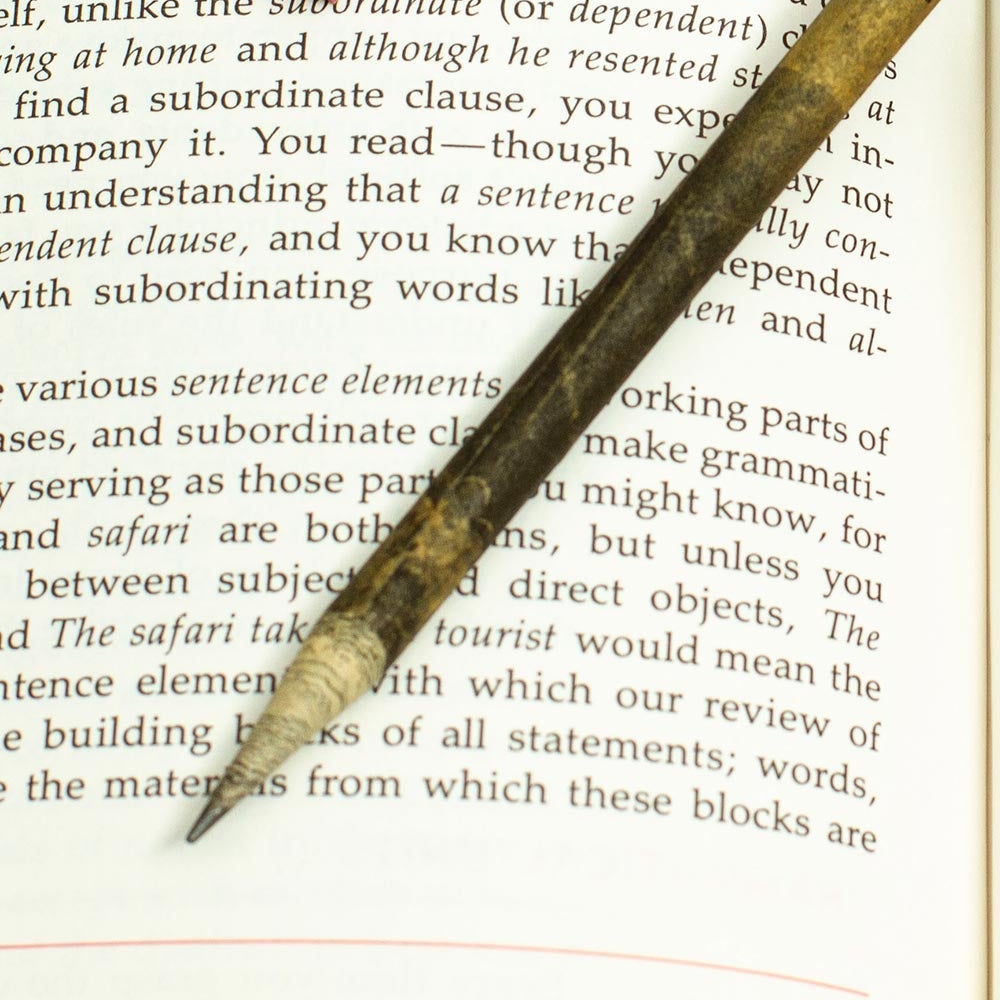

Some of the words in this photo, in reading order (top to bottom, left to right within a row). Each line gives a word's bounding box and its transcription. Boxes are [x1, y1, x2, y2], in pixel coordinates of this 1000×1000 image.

[122, 36, 218, 67] home
[236, 31, 309, 63] and
[328, 31, 489, 73] although
[568, 49, 719, 83] resented
[13, 86, 90, 120] find
[149, 78, 385, 113] subordinate
[405, 79, 537, 119] clause,
[559, 95, 632, 126] you
[188, 128, 225, 157] it.
[251, 126, 328, 156] You
[43, 173, 329, 213] understanding
[477, 182, 635, 216] sentence
[841, 184, 894, 219] not
[127, 224, 249, 257] clause,
[446, 222, 557, 257] know
[825, 228, 890, 261] con-
[94, 270, 374, 310] subordinating
[396, 273, 519, 305] words
[15, 370, 158, 402] various
[171, 367, 329, 397] sentence
[341, 363, 502, 399] elements
[760, 406, 848, 444] parts
[176, 412, 417, 446] subordinate
[583, 429, 689, 464] make
[700, 446, 886, 501] grammati-
[27, 467, 172, 507] serving
[239, 462, 345, 494] those
[582, 480, 699, 520] might
[713, 487, 828, 542] know,
[87, 513, 190, 557] safari
[306, 511, 393, 544] both
[682, 540, 800, 581] unless
[26, 568, 189, 600] between
[509, 568, 623, 607] direct
[650, 582, 794, 635] objects,
[824, 608, 880, 651] The
[129, 612, 233, 655] safari
[434, 618, 556, 651] tourist
[576, 631, 698, 665] would
[716, 648, 815, 685] mean
[469, 668, 591, 705] which
[705, 697, 831, 737] review
[44, 714, 213, 756] building
[509, 725, 734, 776] statements;
[757, 756, 876, 806] words,
[307, 764, 401, 798] from
[424, 768, 547, 804] which
[693, 787, 810, 837] blocks
[827, 822, 877, 853] are
